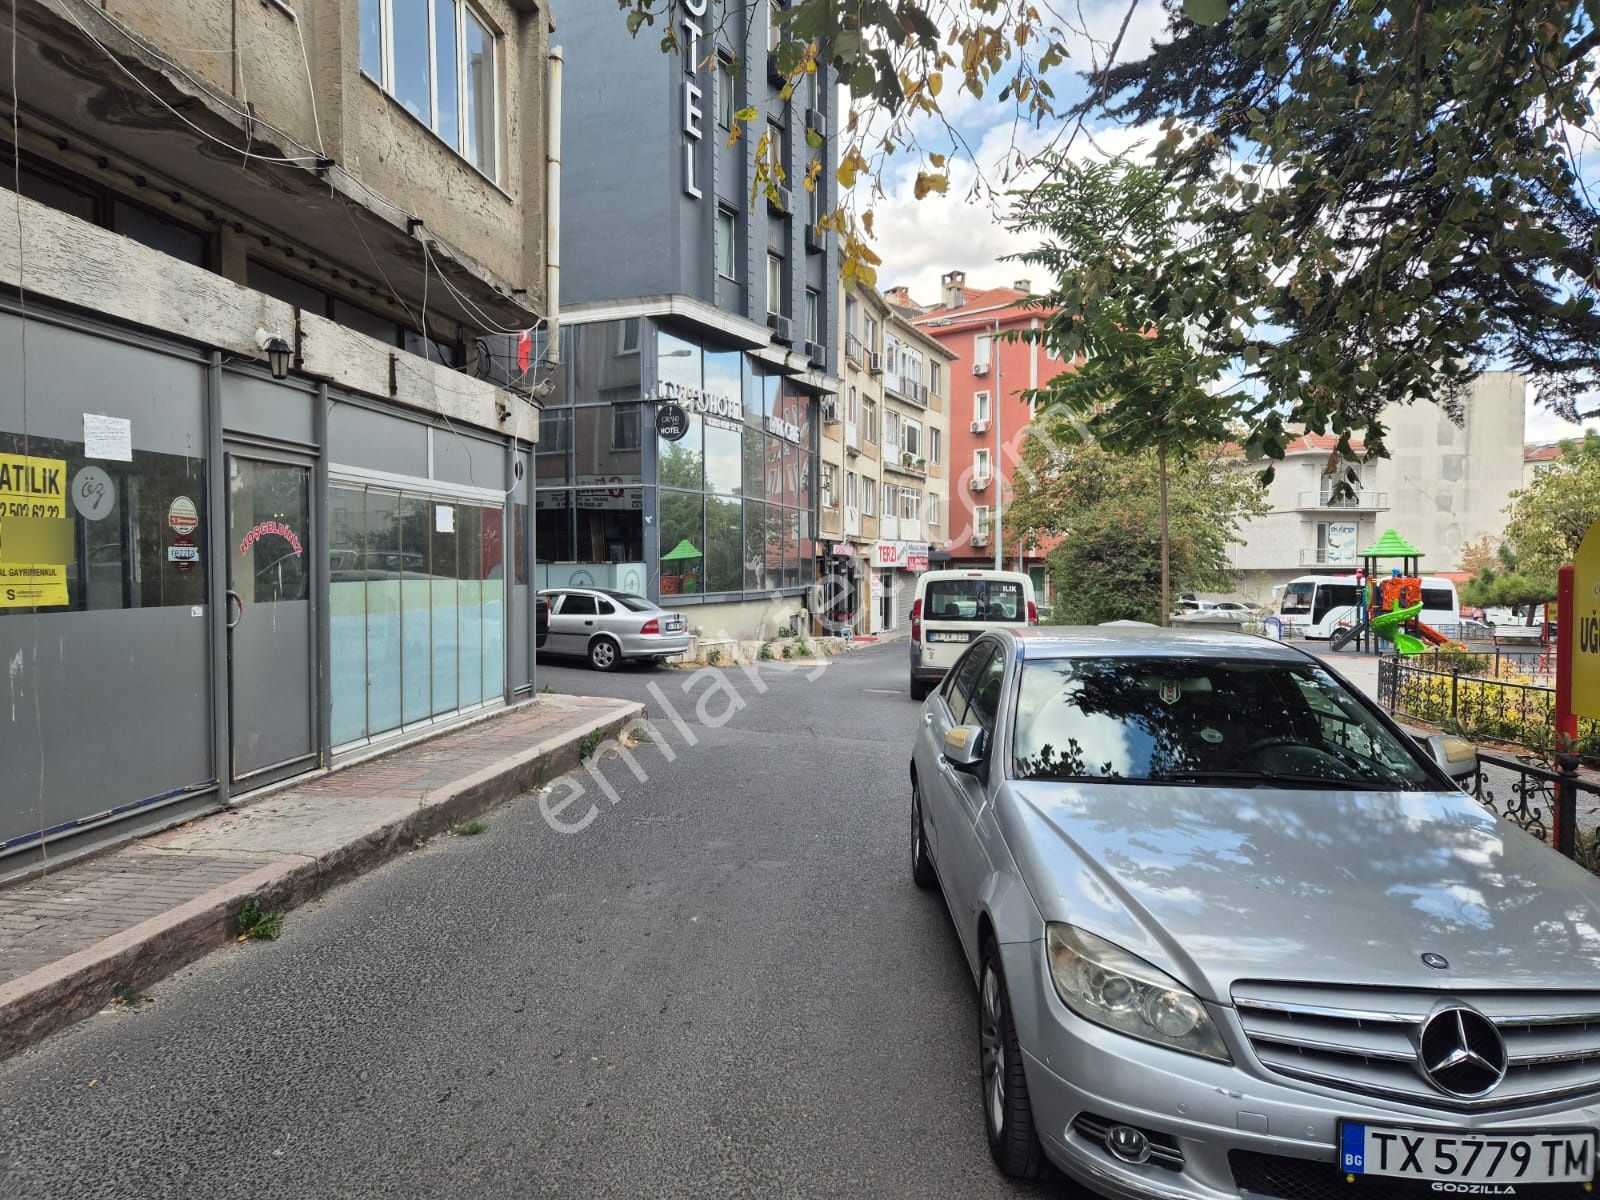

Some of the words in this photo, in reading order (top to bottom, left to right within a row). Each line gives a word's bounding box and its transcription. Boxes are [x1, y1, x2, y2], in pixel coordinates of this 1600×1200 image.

[683, 0, 703, 200] TEL
[661, 426, 681, 434] HOTEL
[1580, 609, 1600, 654] UĞ
[1345, 1154, 1363, 1166] BG
[1372, 1132, 1424, 1173] TX
[1434, 1138, 1531, 1177] 5779
[1542, 1140, 1588, 1177] TM
[1431, 1182, 1516, 1195] GODZILLA
